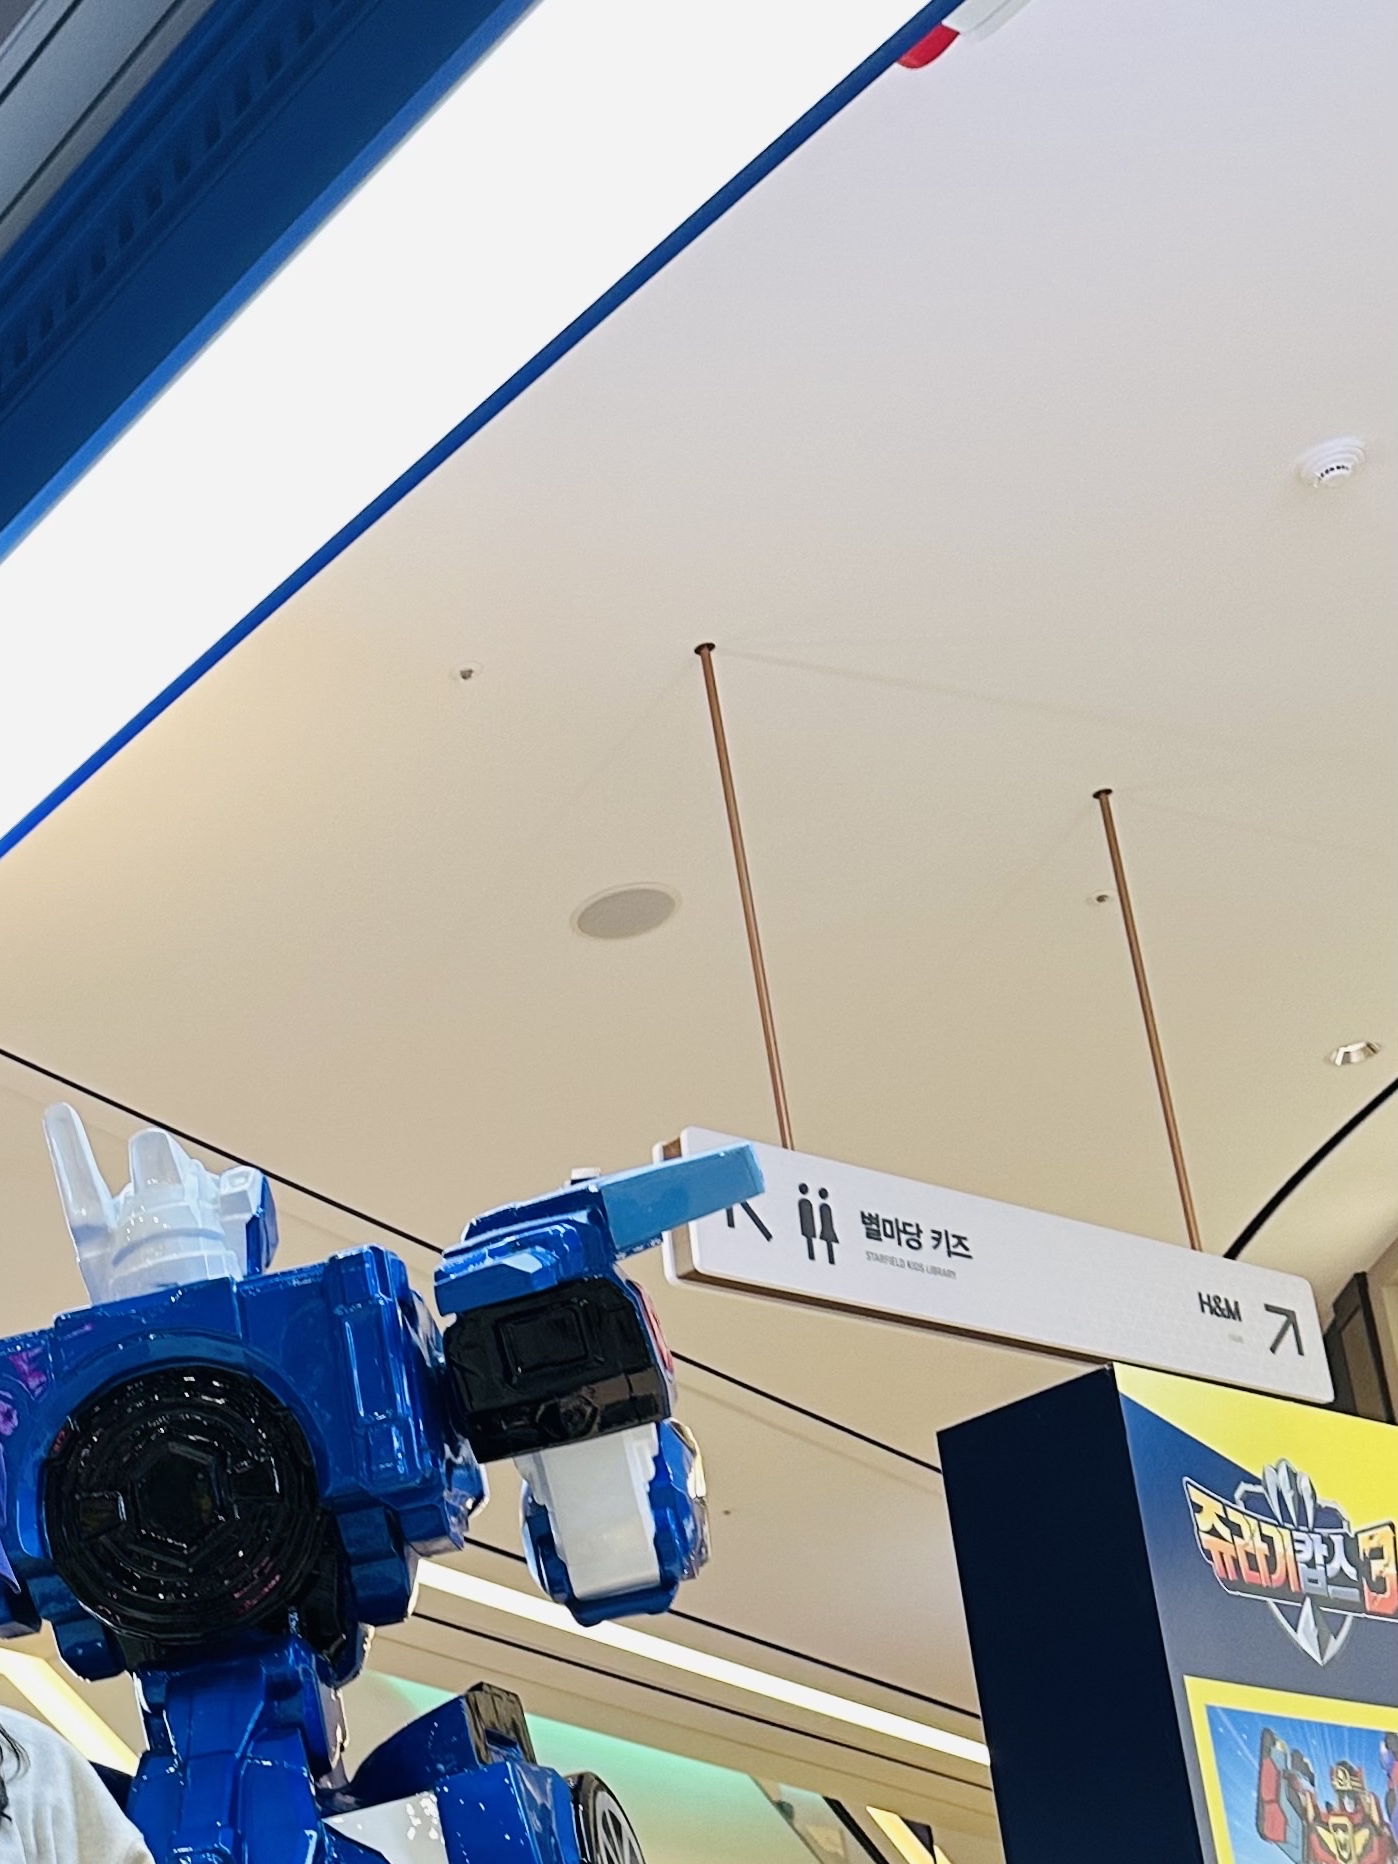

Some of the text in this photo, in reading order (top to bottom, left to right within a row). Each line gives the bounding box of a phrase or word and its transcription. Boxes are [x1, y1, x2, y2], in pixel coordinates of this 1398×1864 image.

[860, 1210, 973, 1260] 별마당 키즈
[1198, 1291, 1243, 1322] H&M
